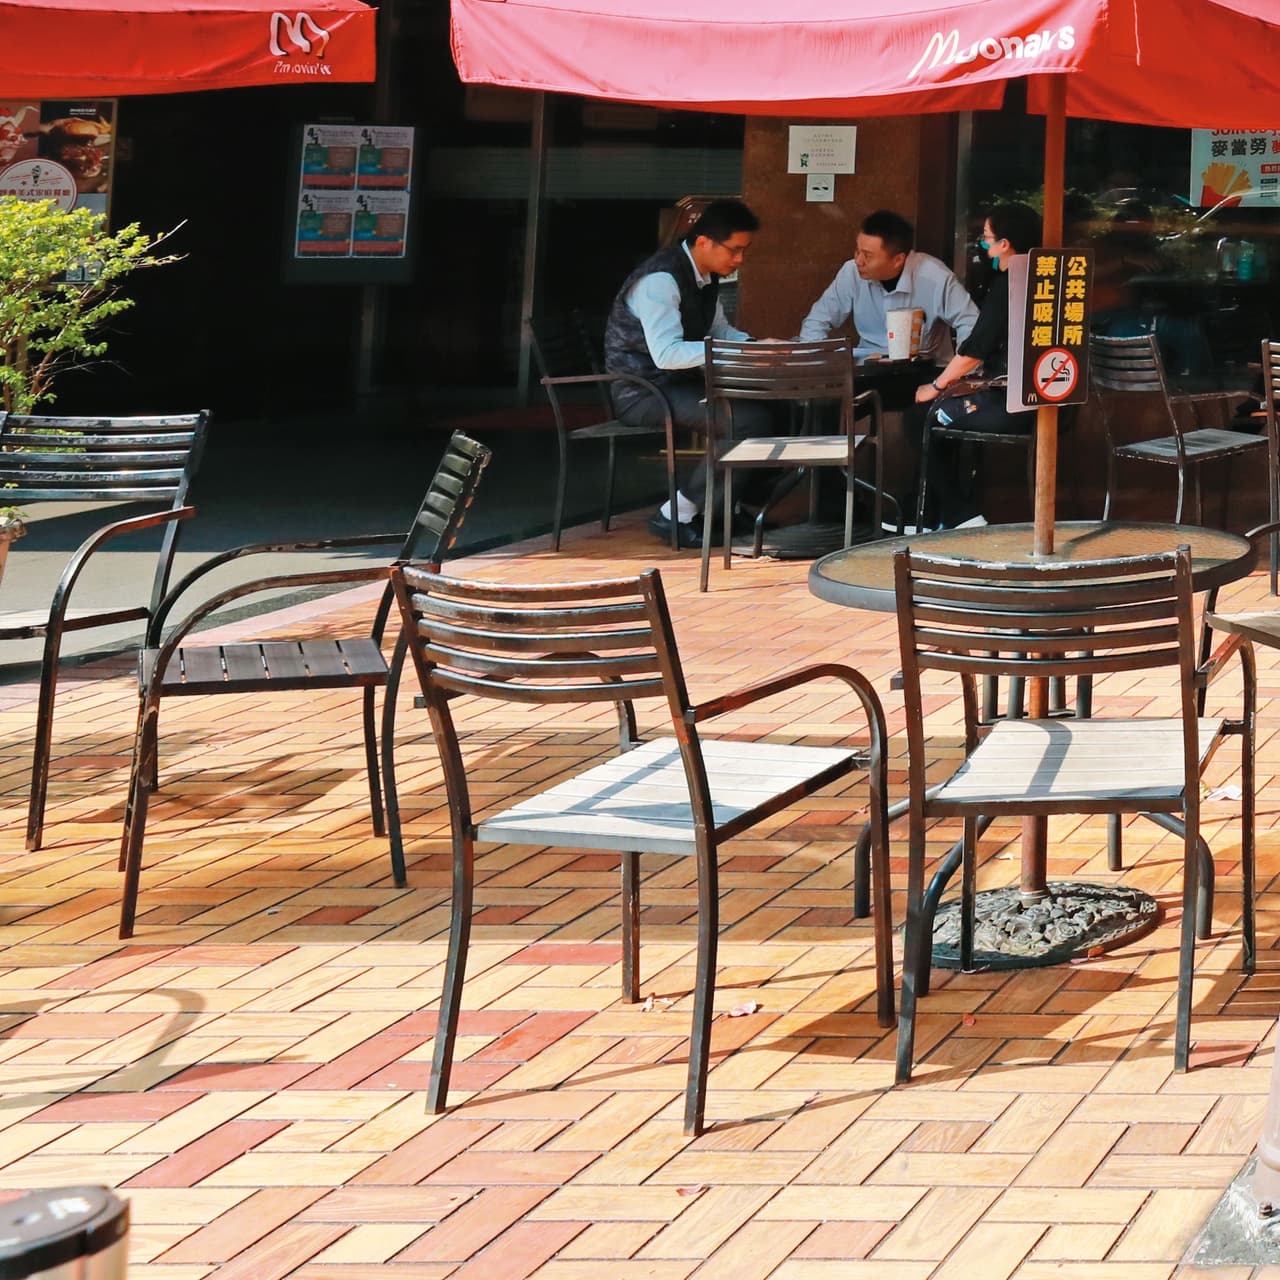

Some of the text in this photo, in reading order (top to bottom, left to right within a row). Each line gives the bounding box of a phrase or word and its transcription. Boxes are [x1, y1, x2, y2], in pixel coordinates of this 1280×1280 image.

[1211, 137, 1267, 158] 麥當勞
[1062, 255, 1088, 346] 公共場所
